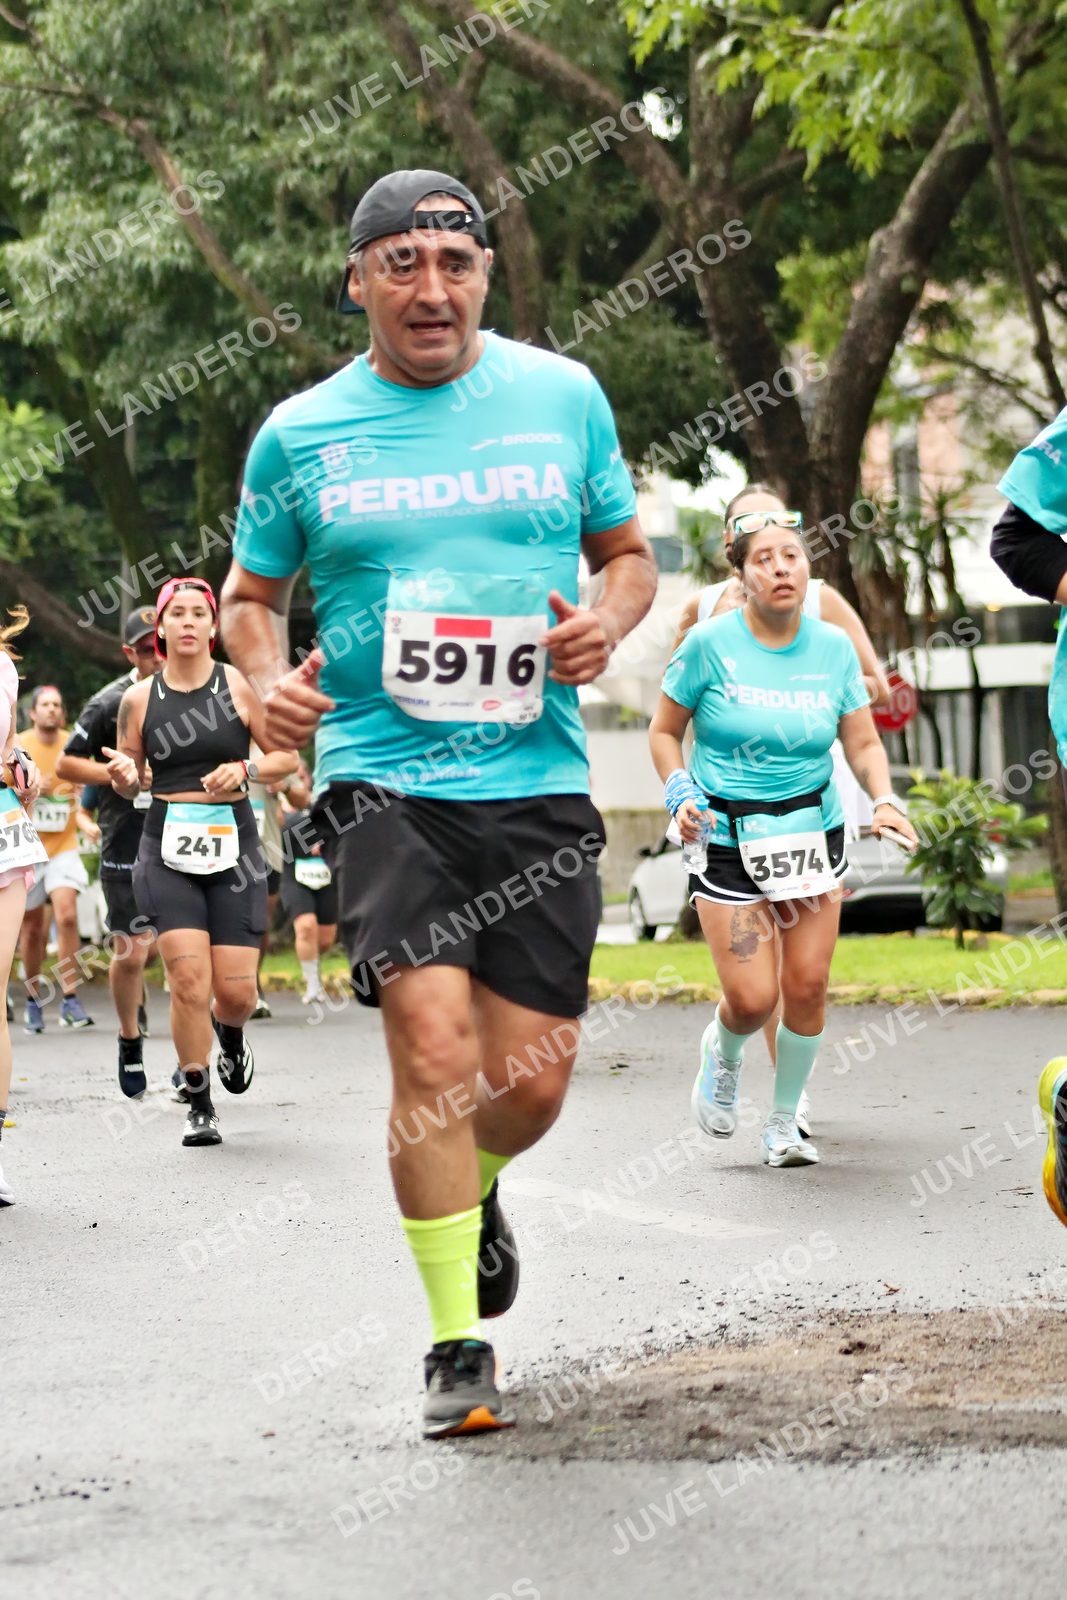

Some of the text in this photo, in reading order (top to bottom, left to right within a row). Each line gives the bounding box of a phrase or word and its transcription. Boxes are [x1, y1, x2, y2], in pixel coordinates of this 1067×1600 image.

[502, 433, 563, 447] BROOKS
[318, 463, 570, 523] PERDURA
[396, 640, 537, 687] 5916
[723, 682, 831, 710] PERDURA
[176, 836, 222, 857] 241
[749, 848, 824, 882] 3574
